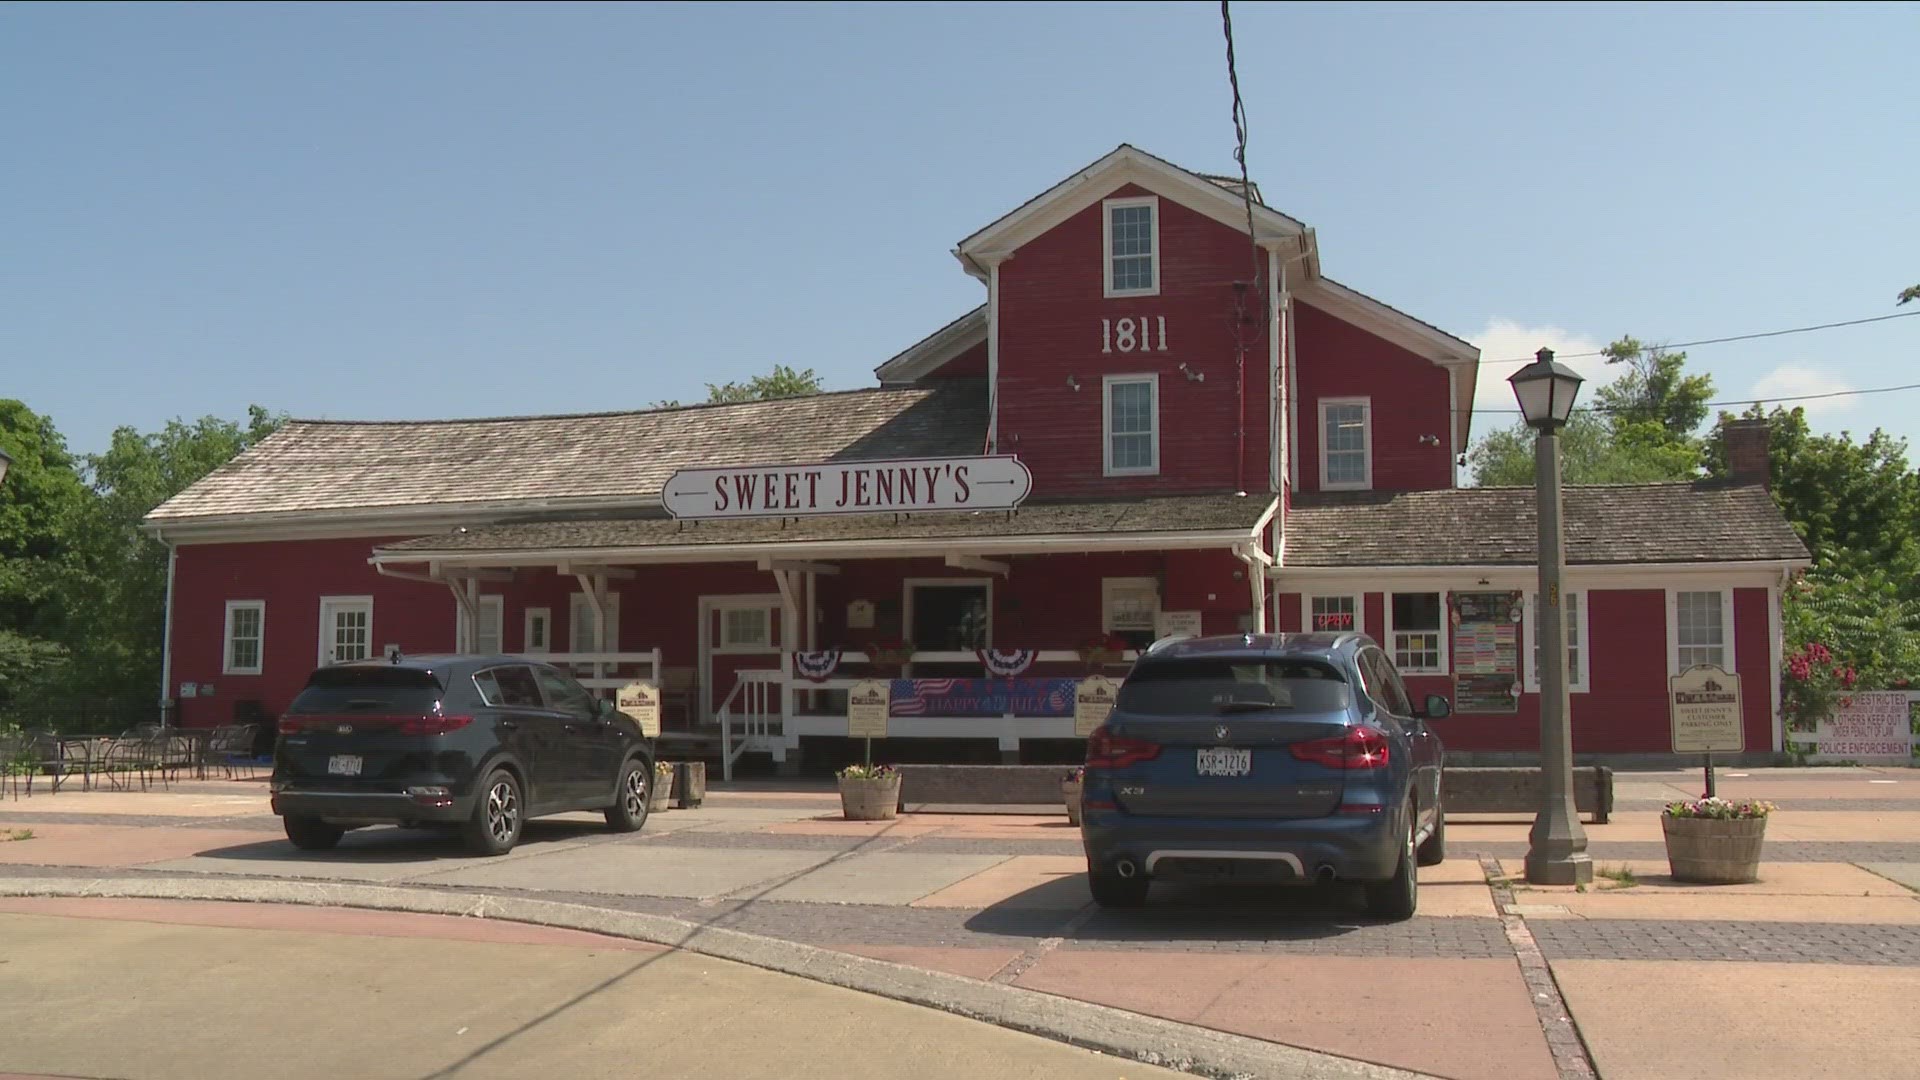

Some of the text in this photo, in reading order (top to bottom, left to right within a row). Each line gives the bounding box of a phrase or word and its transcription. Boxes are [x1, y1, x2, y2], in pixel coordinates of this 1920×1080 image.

[1101, 315, 1168, 353] 1811
[715, 464, 970, 512] SWEET JENNY'S
[1318, 613, 1351, 628] OPEN
[931, 696, 979, 712] HAPPY
[1009, 696, 1048, 714] JULY
[1838, 714, 1865, 726] OTHERS
[1867, 714, 1885, 726] KEEP
[1887, 713, 1900, 726] OUT
[1819, 742, 1908, 754] POLICE ENFORCEMENT
[1120, 787, 1145, 795] X3
